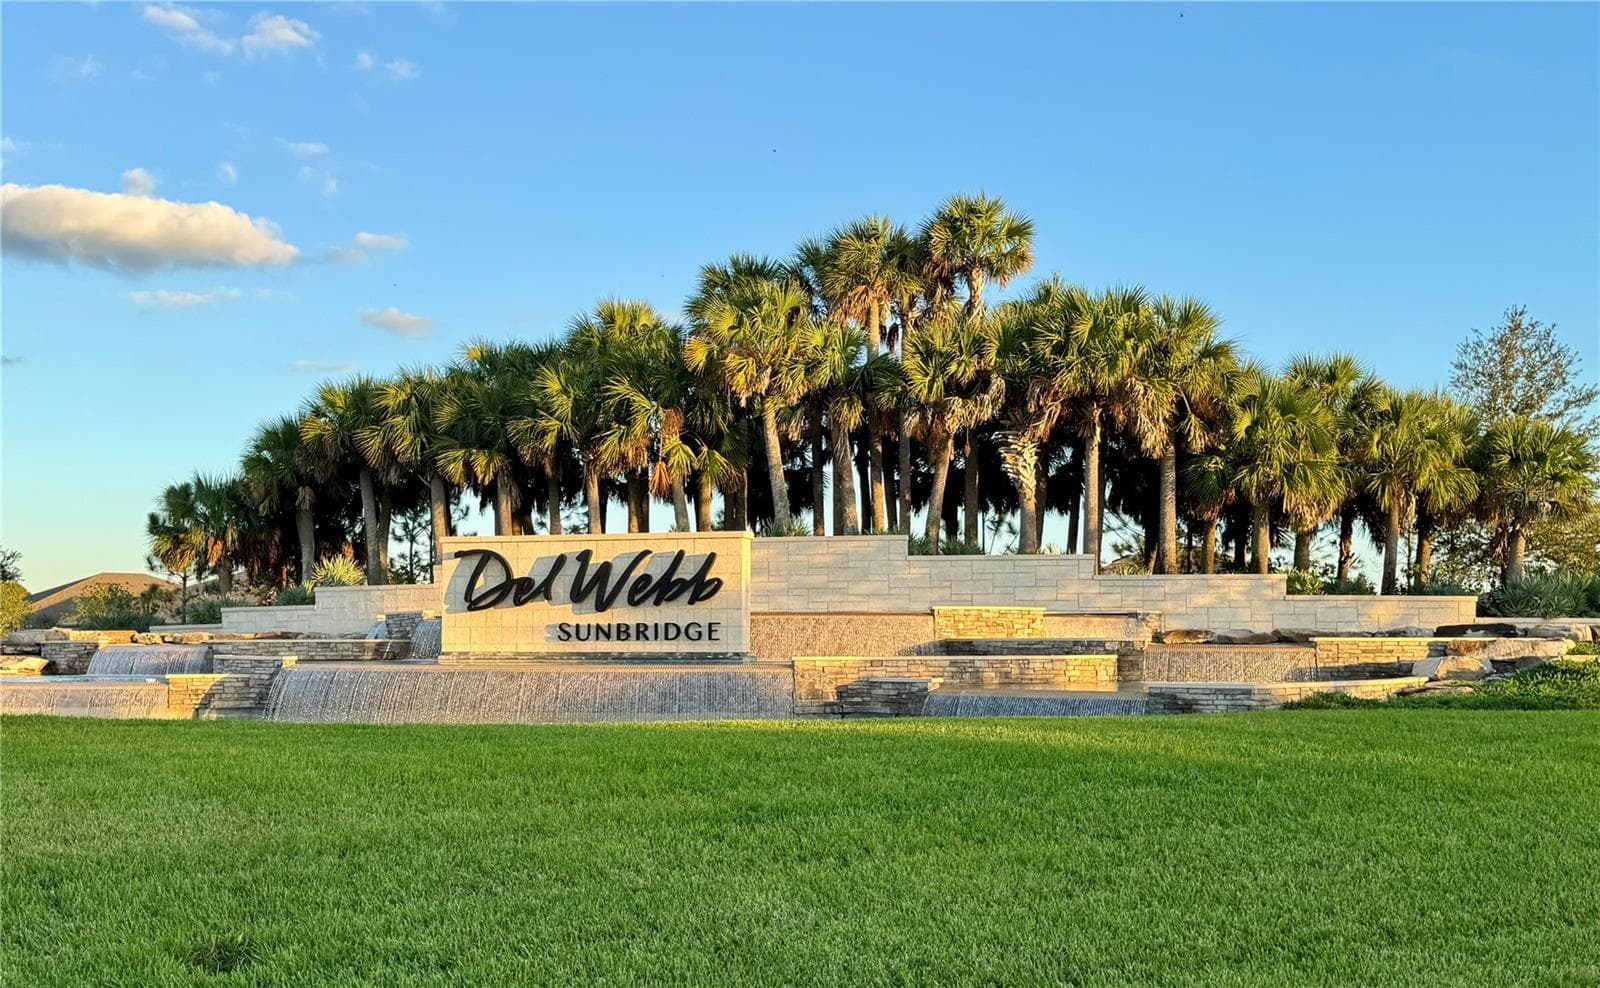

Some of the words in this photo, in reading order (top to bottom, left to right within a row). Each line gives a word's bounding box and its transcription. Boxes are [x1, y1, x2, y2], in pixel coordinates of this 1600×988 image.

[454, 549, 568, 612] Del
[569, 549, 724, 613] Webb
[557, 622, 721, 642] SUNBRIDGE
